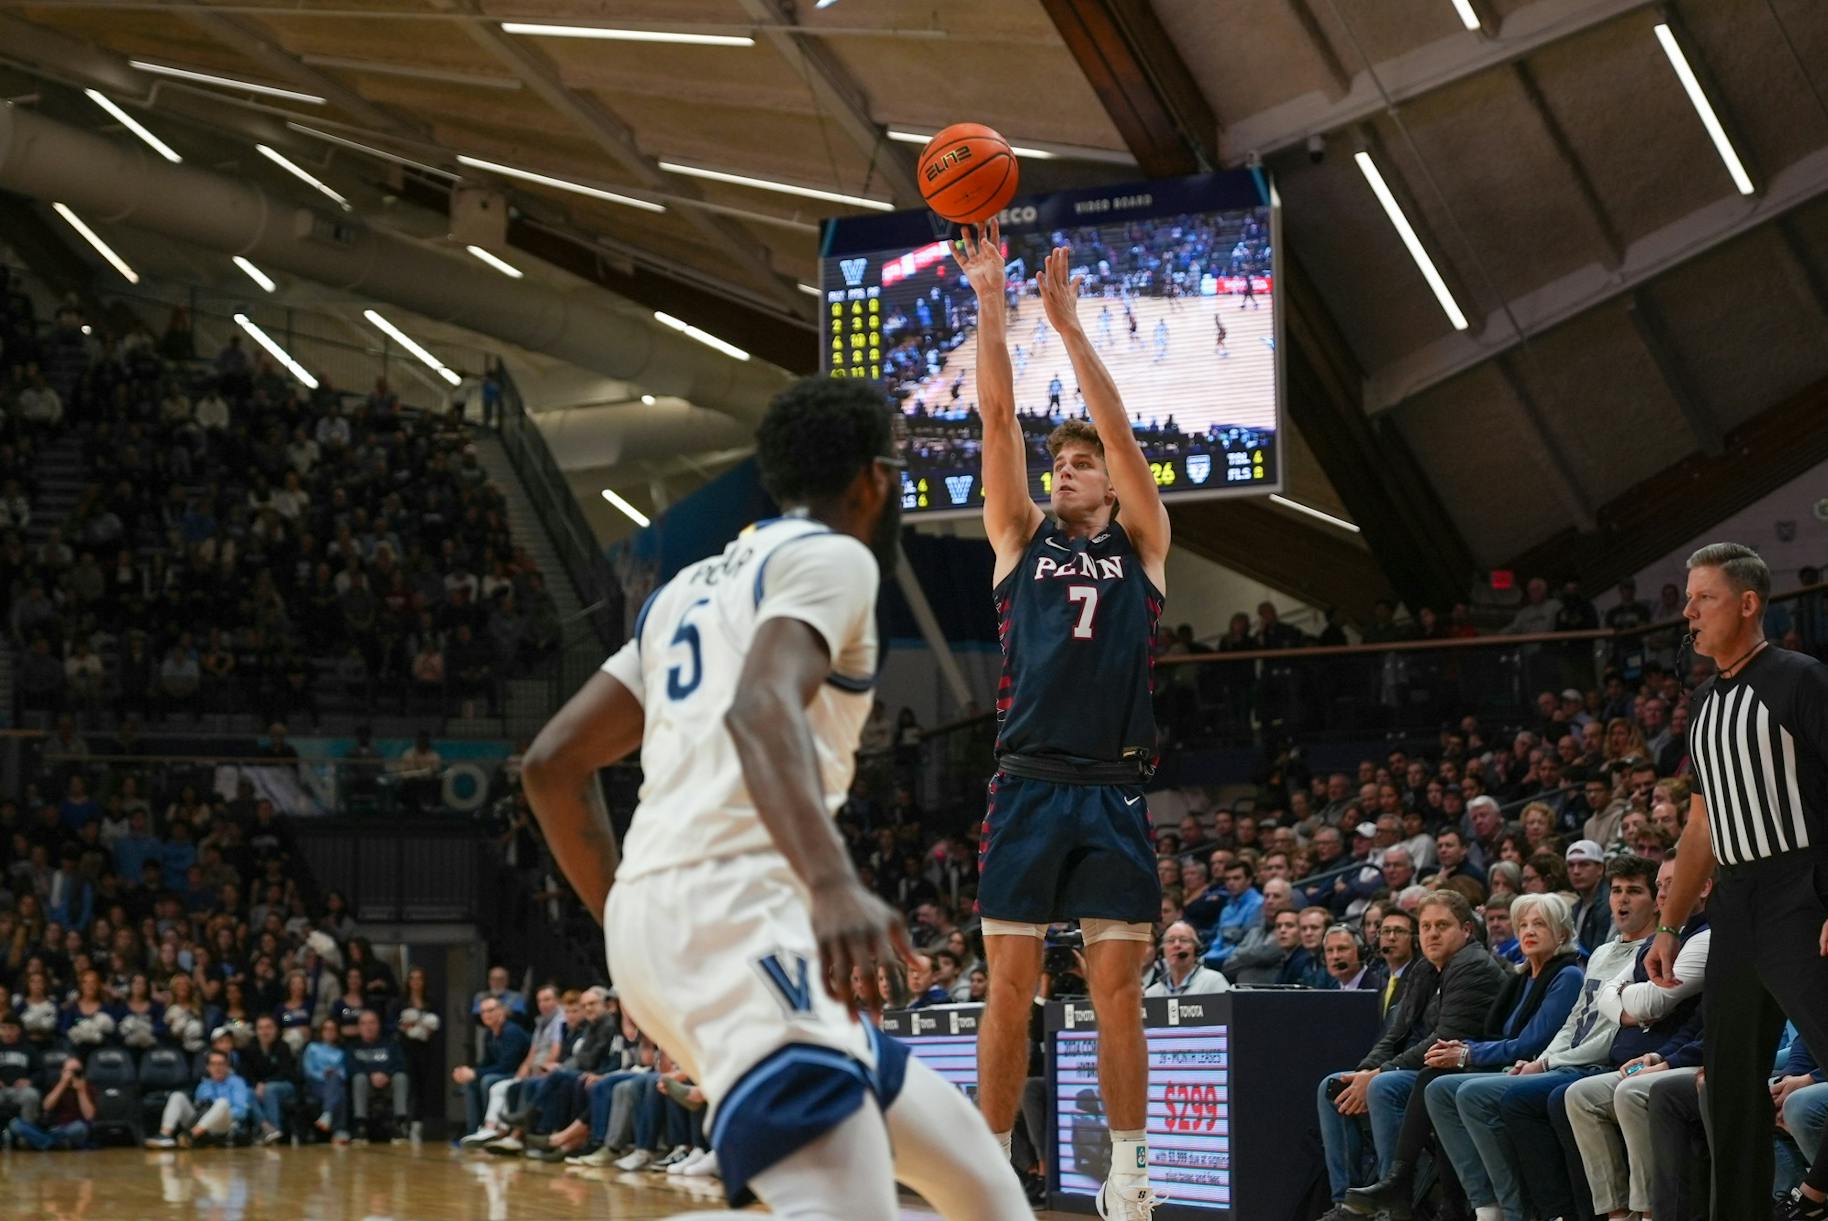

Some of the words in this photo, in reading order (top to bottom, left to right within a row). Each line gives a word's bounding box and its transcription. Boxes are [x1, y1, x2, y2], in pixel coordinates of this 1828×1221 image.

[925, 145, 972, 182] ELITE
[1000, 206, 1037, 224] ECO
[1075, 197, 1110, 214] VIDEO
[1113, 194, 1153, 210] BOARD
[1068, 584, 1099, 640] 7
[667, 598, 710, 702] 5
[1178, 1005, 1203, 1018] TOYOTA
[1164, 1080, 1218, 1132] $299
